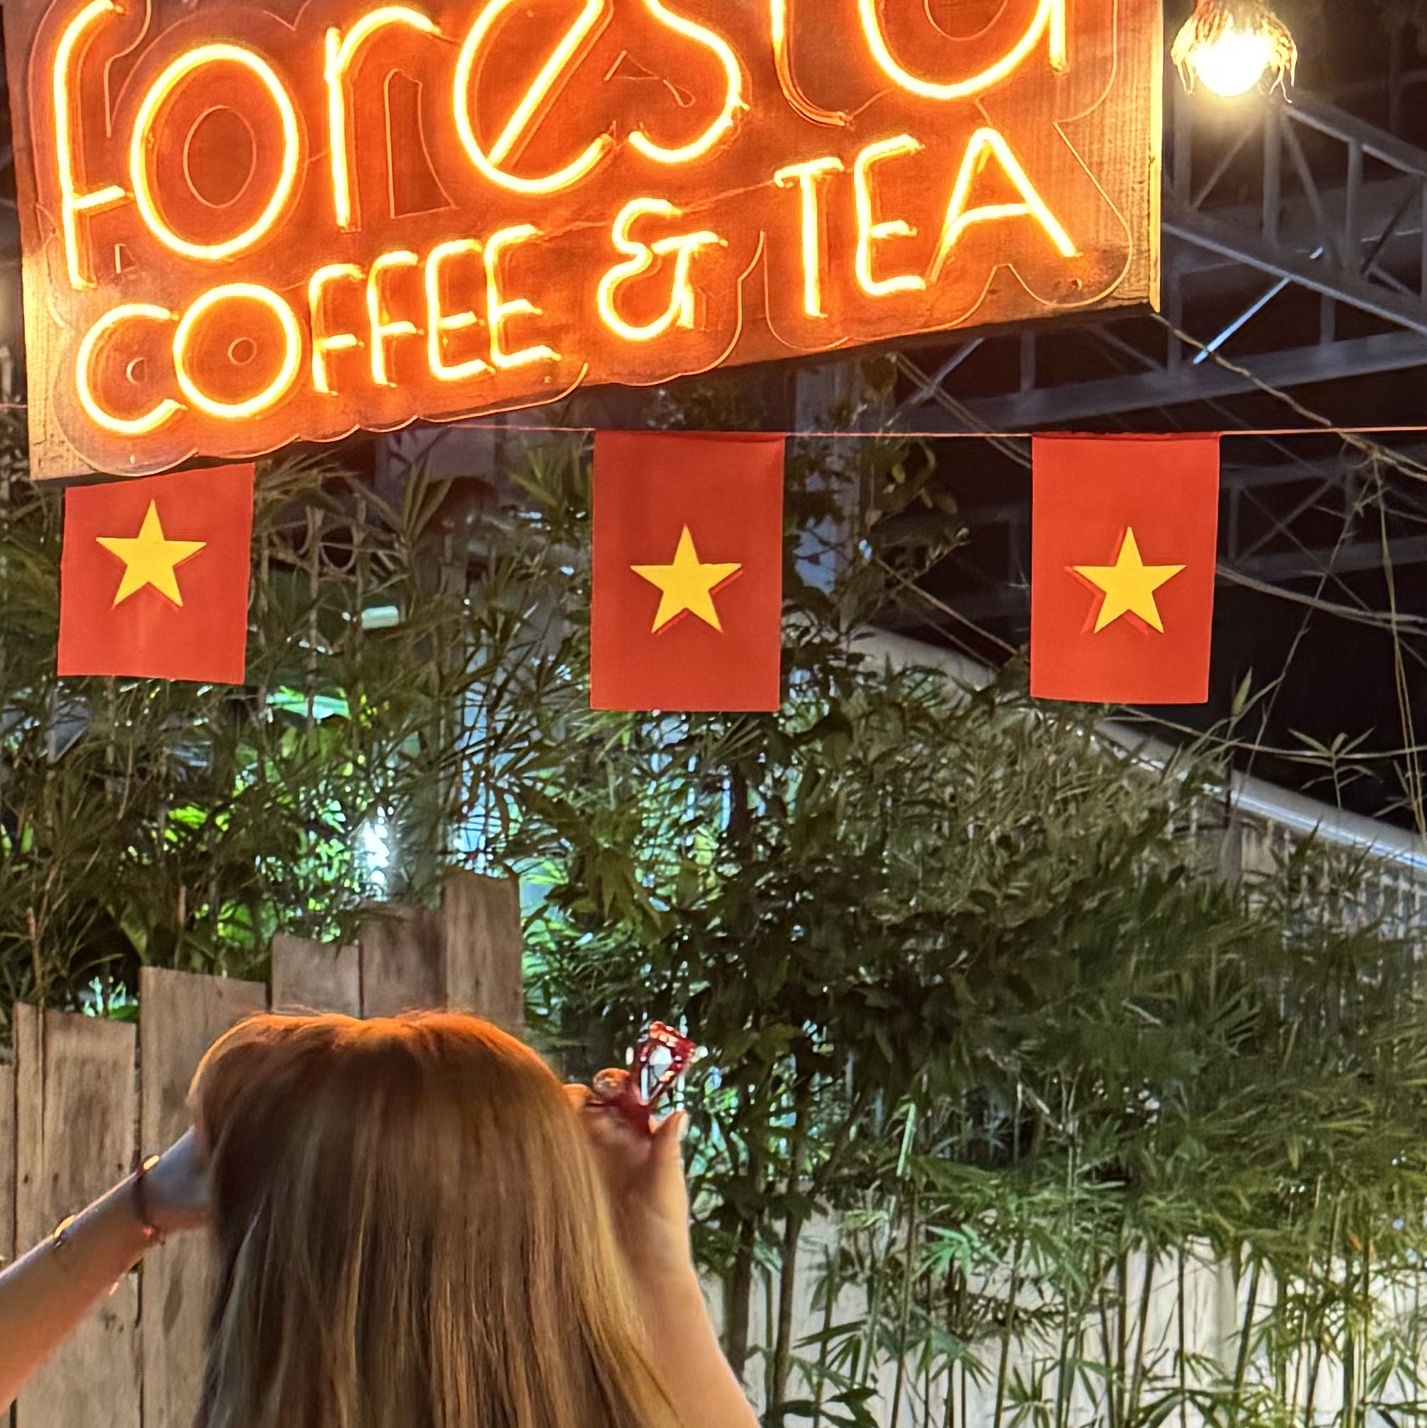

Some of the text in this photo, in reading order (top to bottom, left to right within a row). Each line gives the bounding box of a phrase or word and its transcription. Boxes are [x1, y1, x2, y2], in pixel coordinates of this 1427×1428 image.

[74, 127, 1081, 434] COFFEE & TEA
